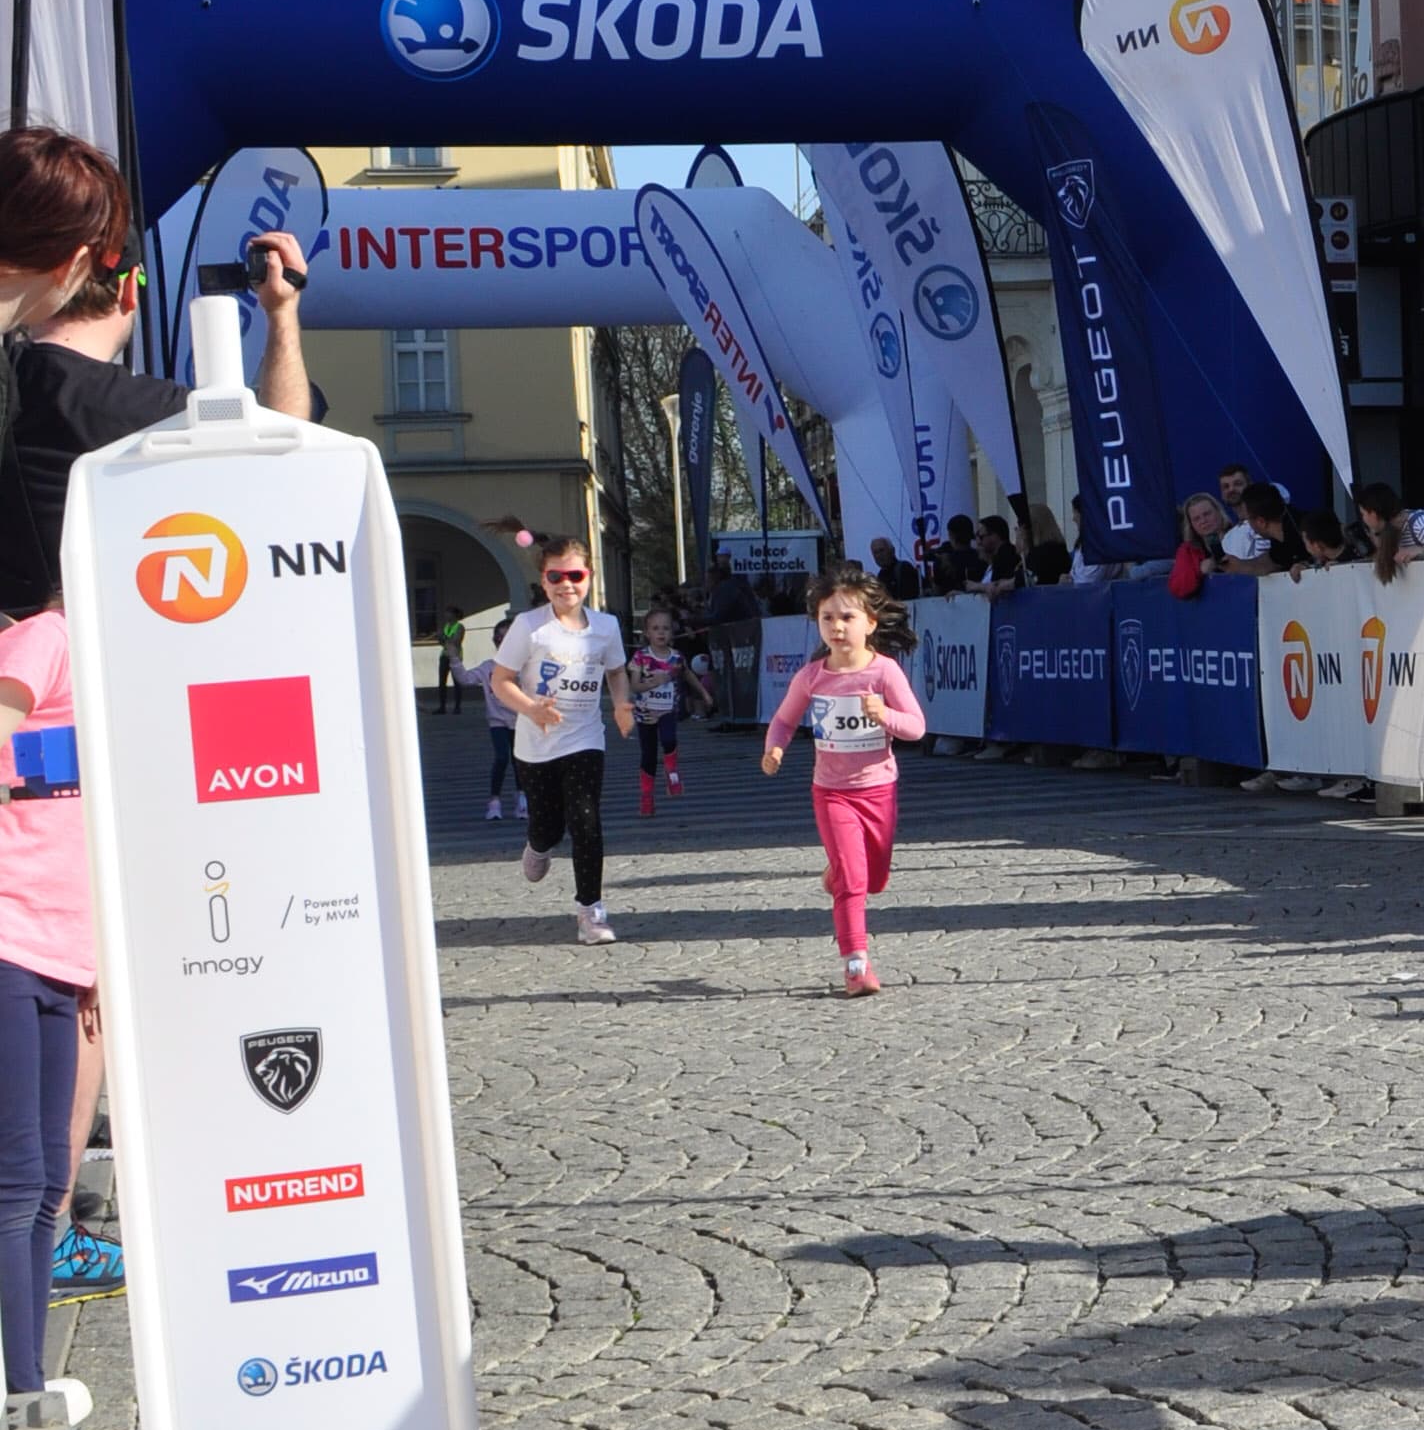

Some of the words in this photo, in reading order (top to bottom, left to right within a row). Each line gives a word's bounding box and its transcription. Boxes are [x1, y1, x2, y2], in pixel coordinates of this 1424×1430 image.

[339, 226, 650, 269] INTERSPOR
[1073, 244, 1134, 530] PEUGEOT
[688, 391, 703, 465] gorenje
[269, 541, 347, 577] NN
[735, 558, 805, 573] hitchcock
[749, 545, 788, 558] lekce
[937, 636, 977, 691] ŠKODA
[1019, 648, 1106, 680] PEUGEOT
[1148, 648, 1253, 688] PEUGEOT
[1317, 652, 1342, 685] NN
[1389, 652, 1417, 686] NN
[560, 679, 598, 692] 3068
[208, 762, 305, 792] AVON
[304, 895, 359, 910] Powered
[305, 912, 321, 925] by
[325, 909, 360, 922] MVM
[182, 954, 263, 976] innogy
[248, 1034, 315, 1049] PEUGEOT
[233, 1173, 358, 1205] NUTREND
[285, 1350, 388, 1387] ŠKODA
